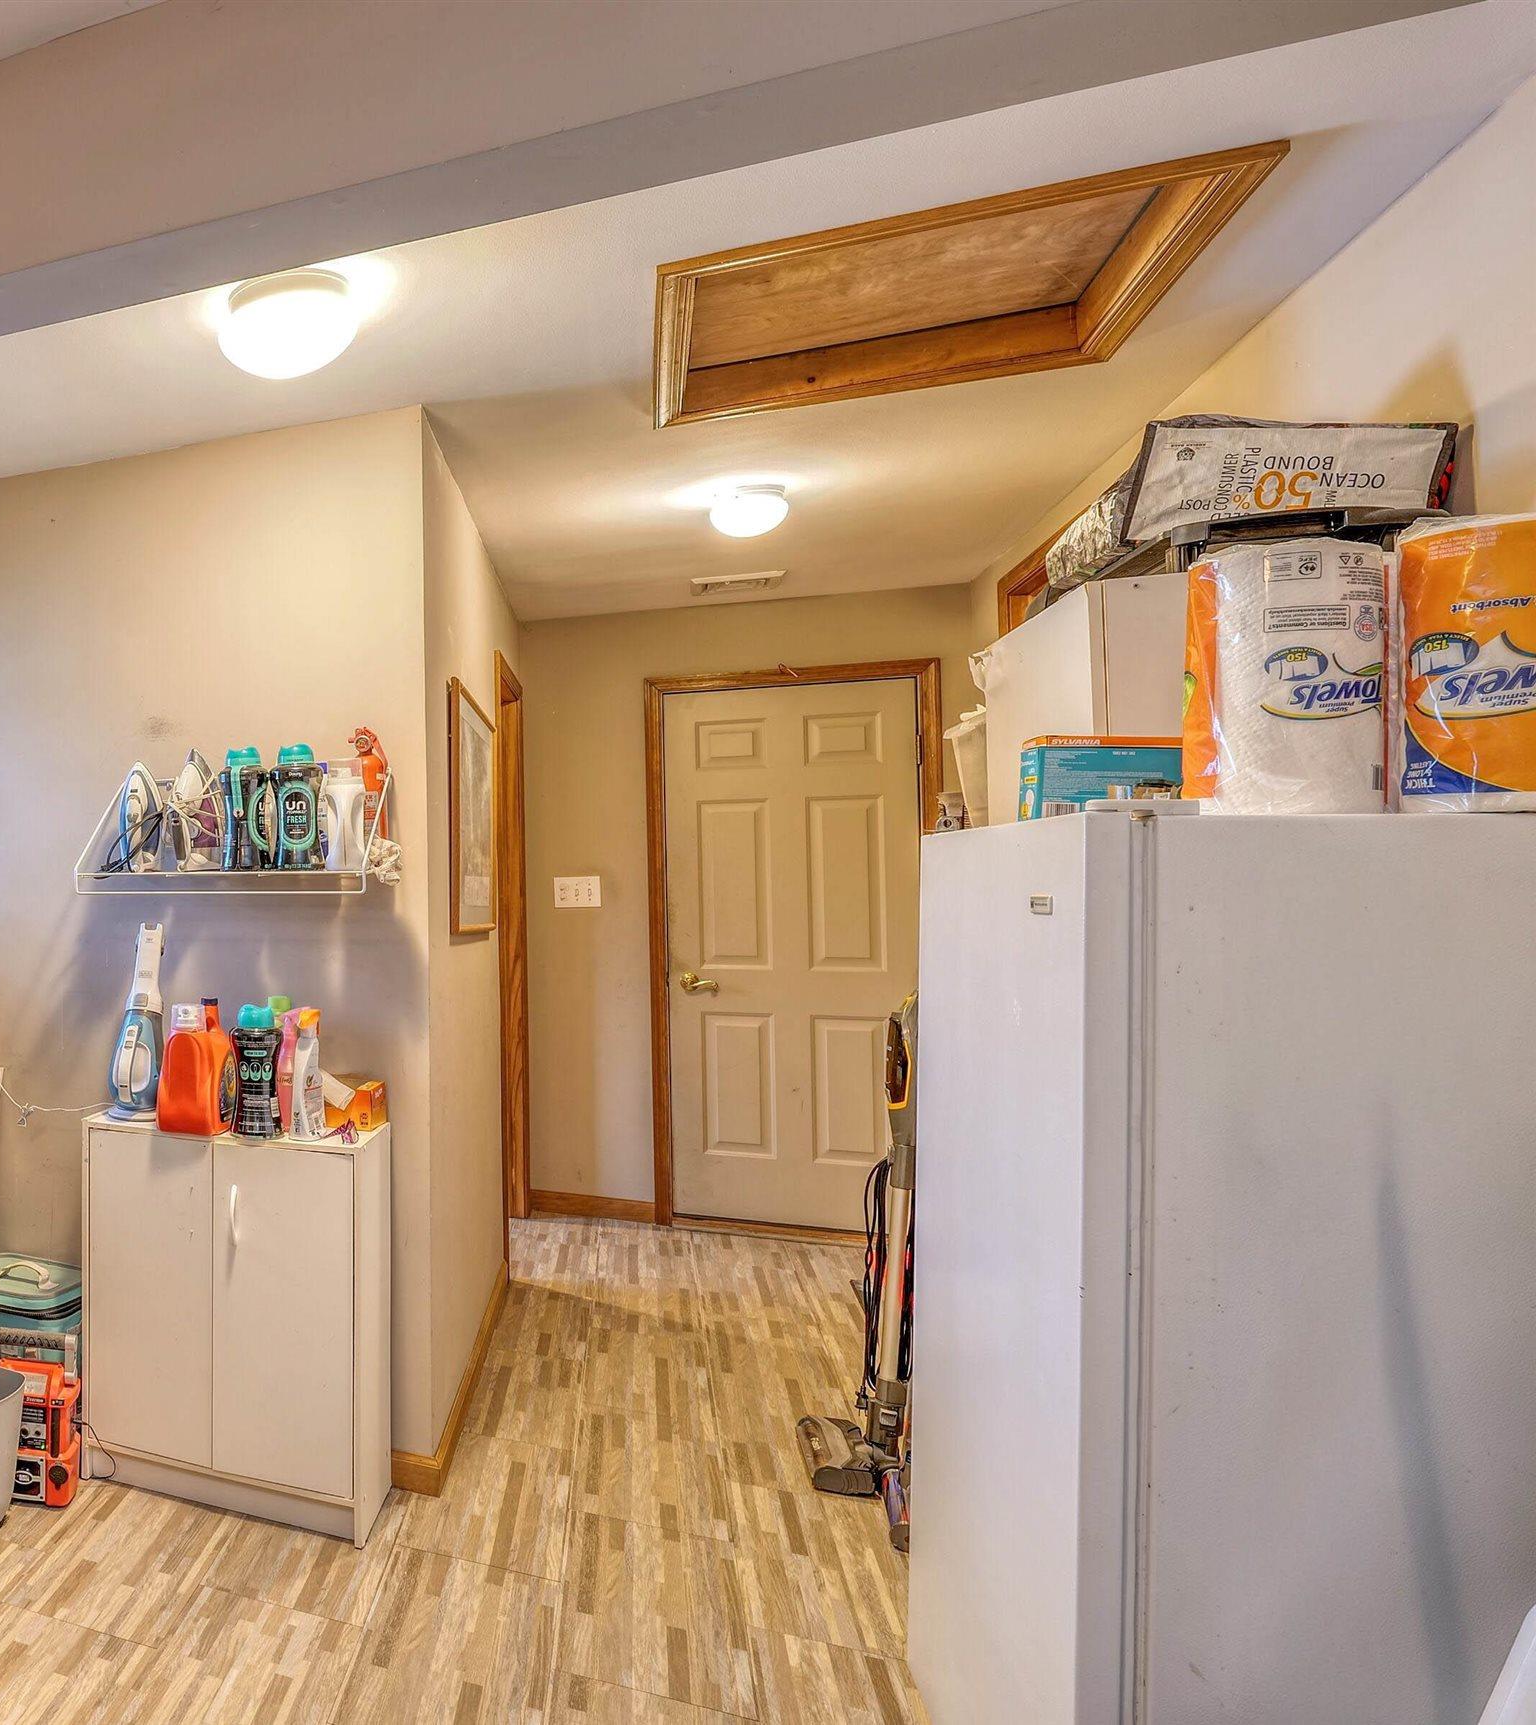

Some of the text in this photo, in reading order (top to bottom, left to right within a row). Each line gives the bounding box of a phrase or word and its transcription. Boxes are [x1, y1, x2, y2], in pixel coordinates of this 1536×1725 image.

[1236, 447, 1261, 493] PLASTIC
[1264, 456, 1334, 471] BOUND
[1214, 453, 1239, 511] CONSUMER
[1320, 472, 1385, 489] OCEAN
[1177, 499, 1211, 510] POST
[1450, 597, 1531, 614] Absorbent
[1424, 640, 1449, 653] 150
[1287, 652, 1307, 662] 150
[1290, 675, 1382, 710] Towels
[1440, 667, 1536, 706] wels
[1489, 697, 1529, 708] Super
[1051, 738, 1101, 746] SYLVANIA
[286, 815, 307, 824] FRESH
